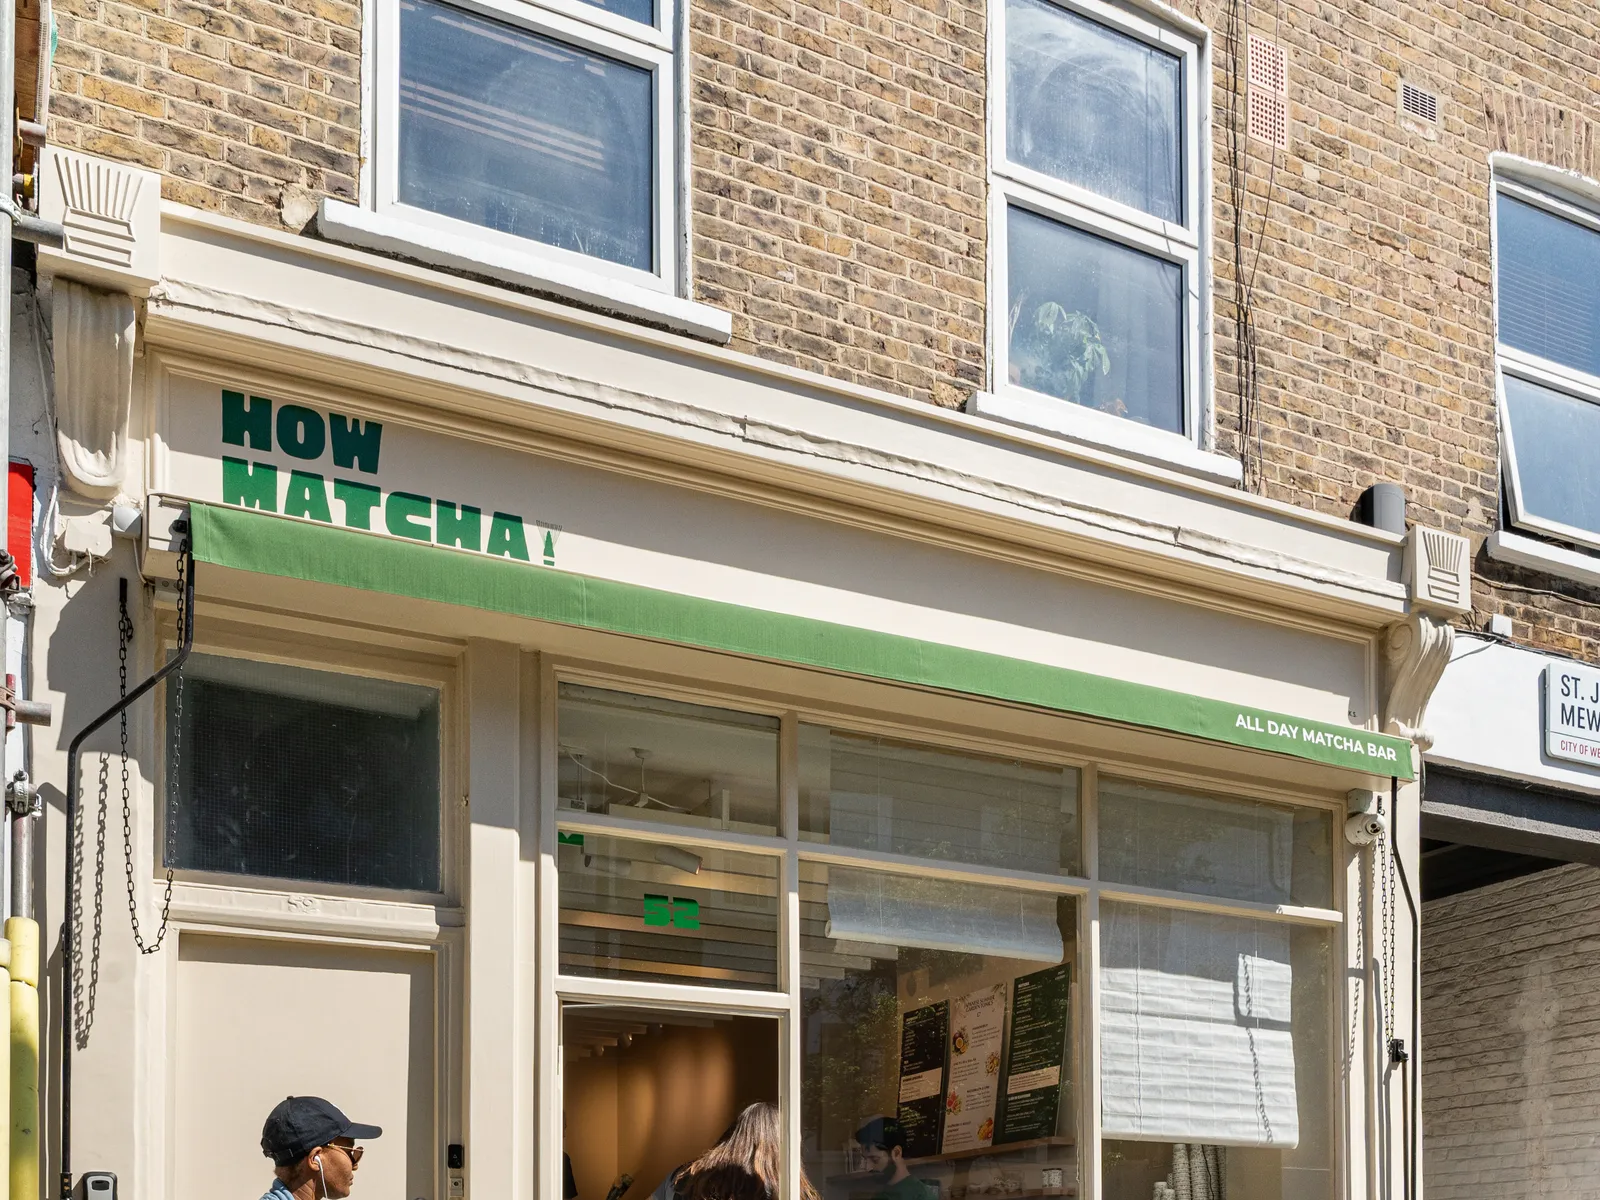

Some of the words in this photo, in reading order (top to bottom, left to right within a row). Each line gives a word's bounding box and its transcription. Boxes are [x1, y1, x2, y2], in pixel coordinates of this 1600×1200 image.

[222, 389, 383, 474] HOW
[1561, 674, 1585, 700] ST.
[1561, 702, 1600, 732] MEW
[1235, 714, 1264, 732] ALL
[1268, 720, 1298, 739] DAY
[1302, 728, 1364, 754] MATCHA
[1367, 743, 1397, 761] BAR
[1560, 740, 1577, 753] CITY
[1579, 744, 1589, 756] OF
[644, 893, 700, 930] 52
